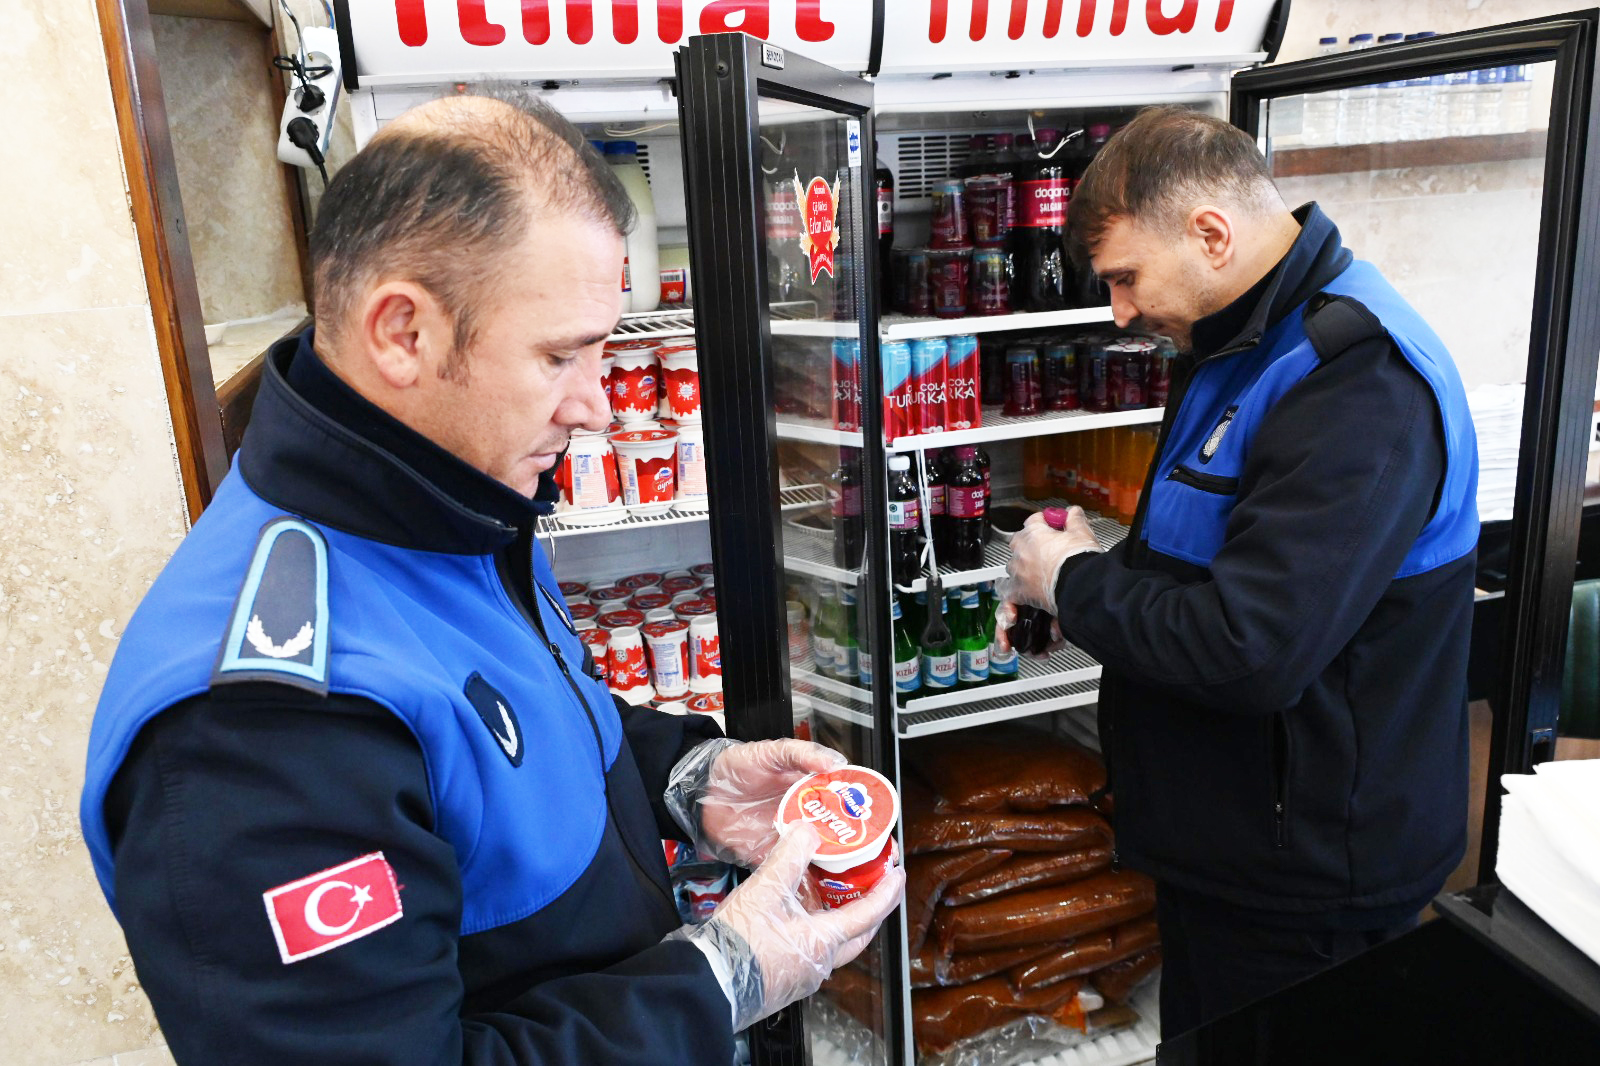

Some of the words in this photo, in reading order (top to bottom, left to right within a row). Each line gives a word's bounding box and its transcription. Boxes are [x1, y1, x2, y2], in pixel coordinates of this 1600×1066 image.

[920, 382, 947, 392] COLA
[802, 799, 857, 845] ayran
[826, 891, 861, 905] ayran
